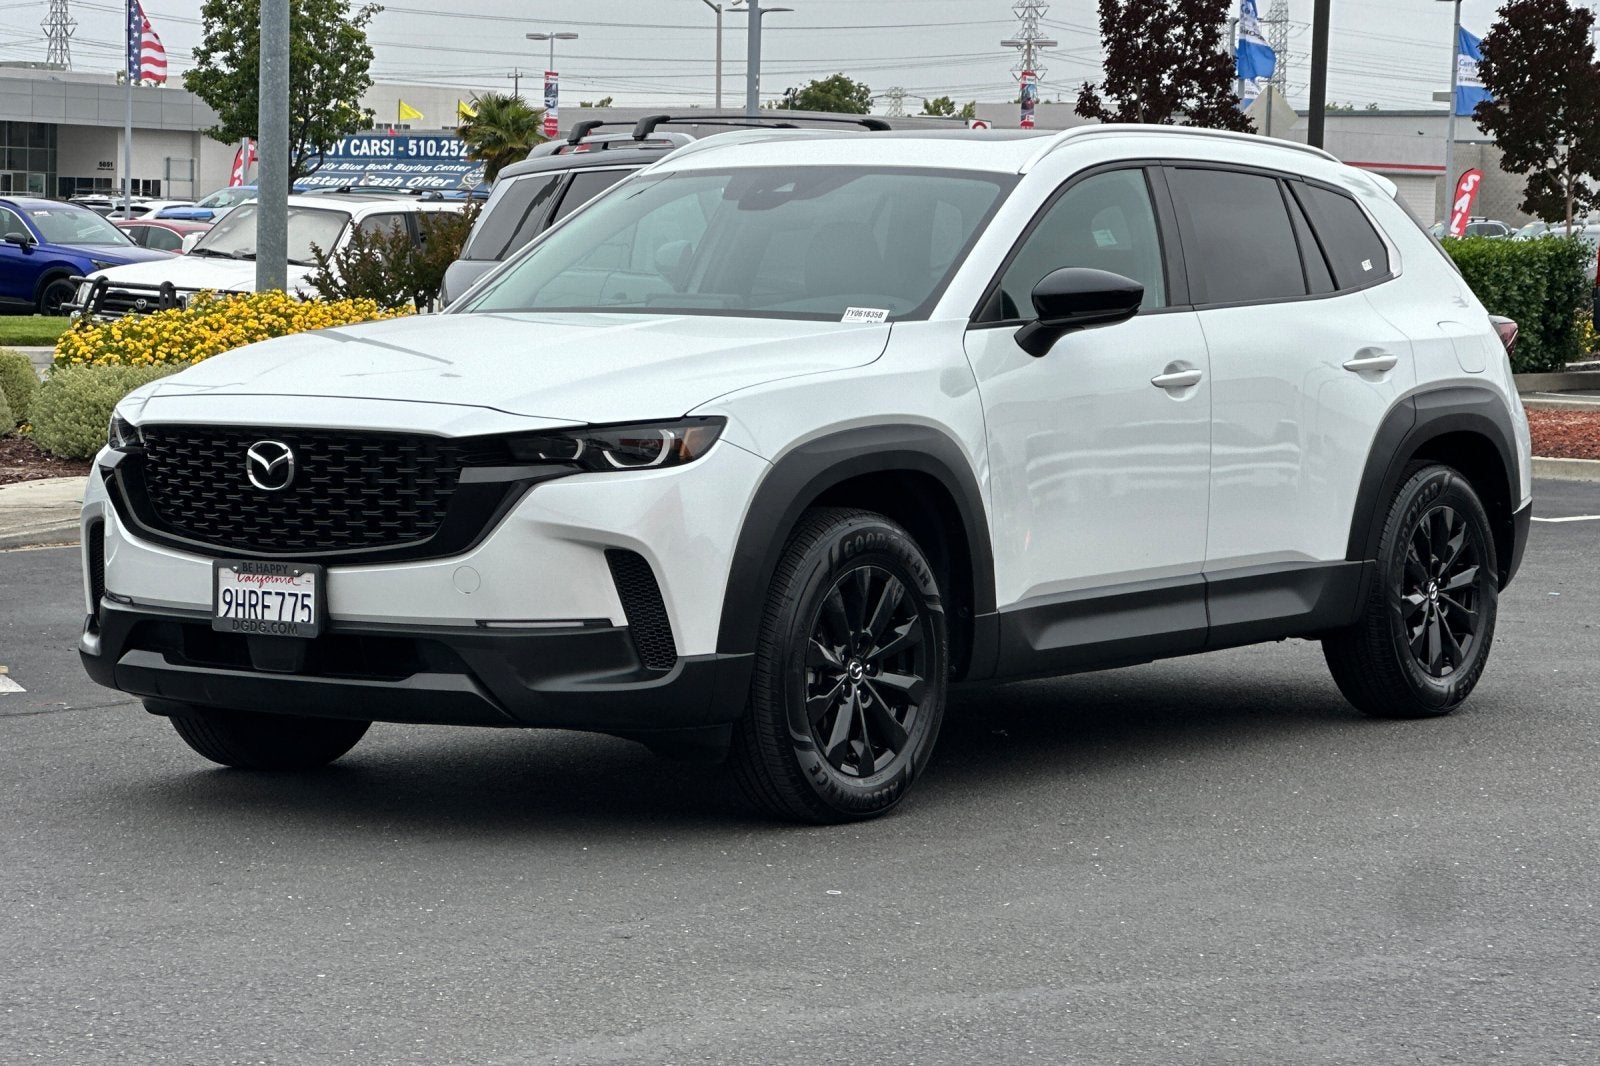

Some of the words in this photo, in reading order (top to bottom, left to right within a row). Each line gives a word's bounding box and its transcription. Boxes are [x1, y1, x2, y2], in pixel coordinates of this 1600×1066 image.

[350, 138, 394, 156] CARS!
[338, 163, 364, 171] Blue
[365, 163, 393, 171] Book
[394, 163, 432, 173] Buying
[433, 164, 471, 172] Center
[406, 176, 455, 187] Offer
[242, 562, 253, 573] BE
[256, 563, 288, 574] HAPPY
[222, 588, 312, 623] 9HRF775
[232, 620, 298, 634] DGDG.COM
